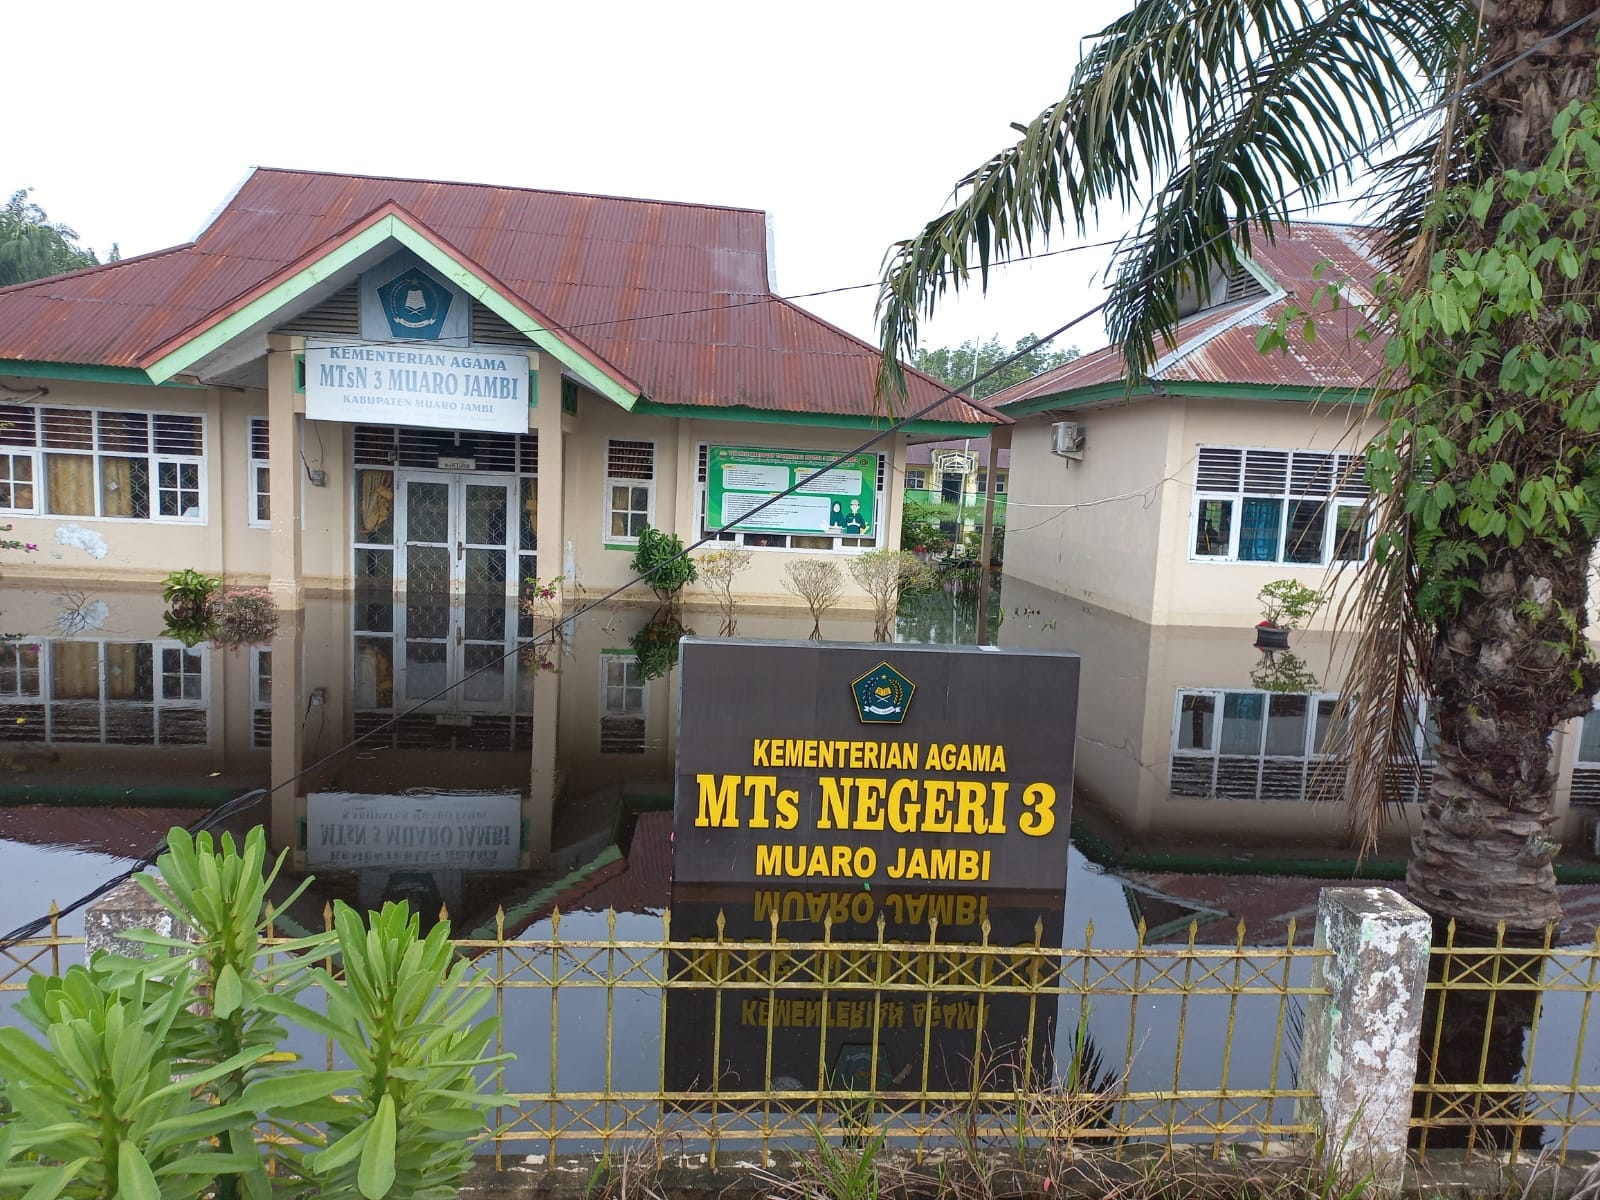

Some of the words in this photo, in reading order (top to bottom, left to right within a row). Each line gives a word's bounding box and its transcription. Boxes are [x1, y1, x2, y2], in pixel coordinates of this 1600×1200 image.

[330, 347, 446, 366] KEMENTERIAN
[450, 356, 507, 371] AGAMA
[320, 363, 367, 388] MTsN
[374, 370, 383, 390] 3
[388, 369, 458, 395] MUARO
[463, 374, 519, 400] JAMBI
[343, 394, 412, 407] KABUPATEN
[415, 399, 458, 410] MUARO
[460, 402, 494, 413] JAMBI
[752, 738, 919, 770] KEMENTERIAN
[925, 743, 1007, 773] AGAMA
[694, 773, 800, 831] MTs
[816, 776, 1010, 835] NEGERI
[1018, 781, 1057, 838] 3
[754, 844, 878, 879] MUARO
[886, 847, 992, 882] JAMBI
